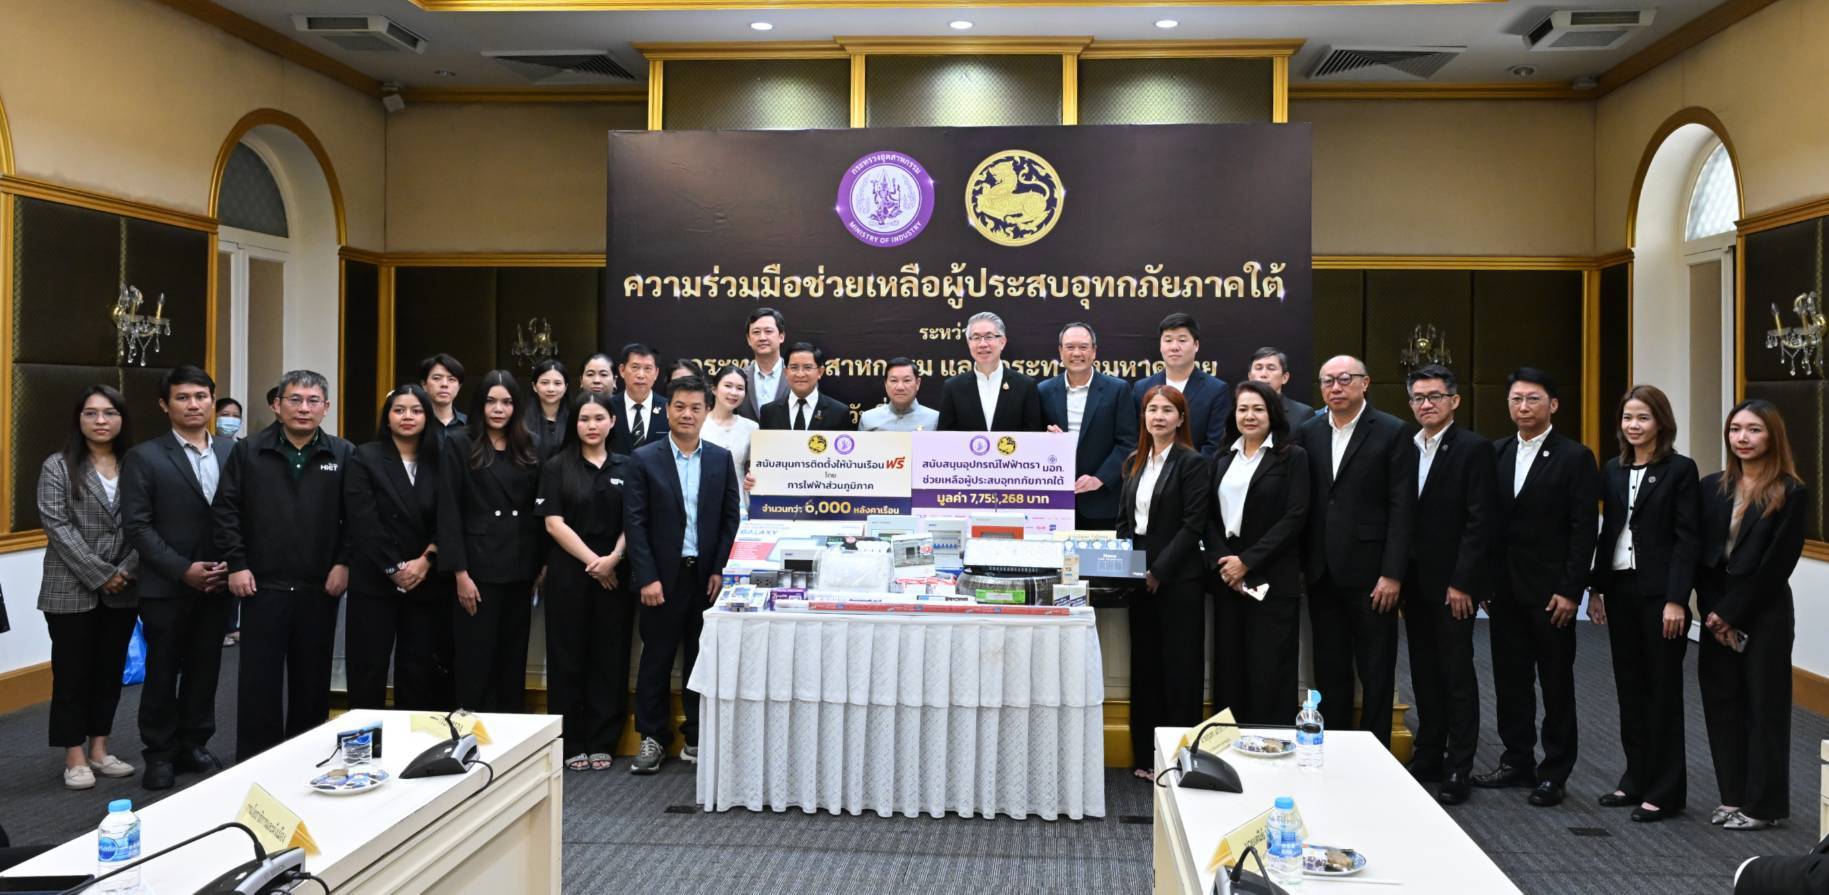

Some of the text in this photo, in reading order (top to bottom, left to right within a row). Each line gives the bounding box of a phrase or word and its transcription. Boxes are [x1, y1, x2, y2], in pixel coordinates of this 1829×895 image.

[849, 221, 879, 242] MINISTRY
[891, 221, 922, 243] INDUSTRY
[623, 261, 1286, 310] ความร่วมมือช่วยเหลือผู้ประสบอุทกภัยภาคใต้
[755, 456, 906, 473] สนับสนุนการติดตั้งให้บ้านเรือน ฟรี
[922, 458, 1065, 473] สนับสนุนอุปกรณ์ไฟฟ้าตรา มอก.
[787, 479, 875, 492] การไฟฟ้าส่วนภูมิภาค
[922, 475, 1065, 487] ช่วยเหลือผู้ประสบอุทกภัยภาคใต้
[936, 491, 968, 506] มูลค่า
[1027, 495, 1050, 504] บาท
[804, 501, 852, 515] 6,000
[853, 505, 900, 515] หลังคาเรือน
